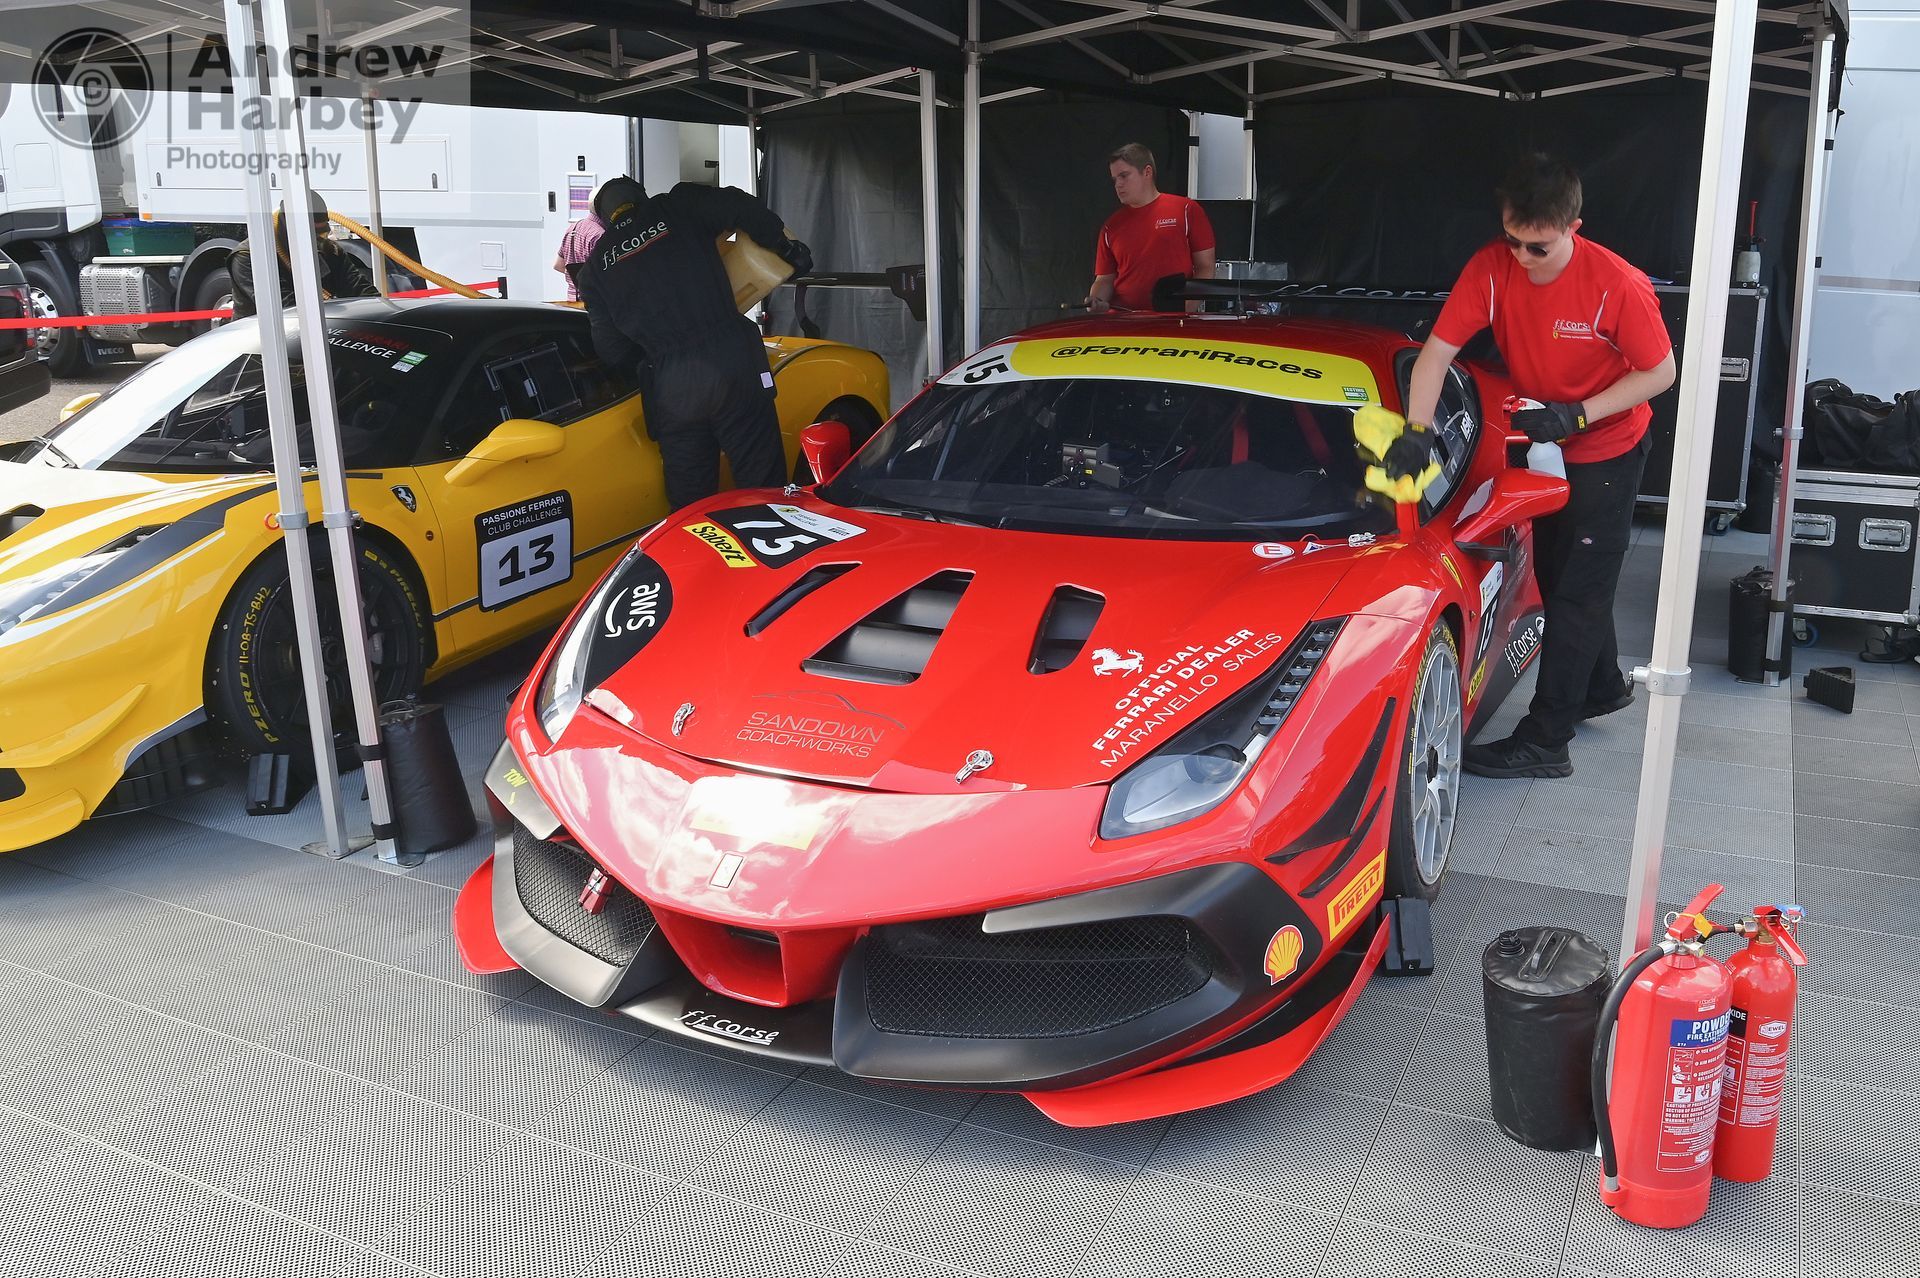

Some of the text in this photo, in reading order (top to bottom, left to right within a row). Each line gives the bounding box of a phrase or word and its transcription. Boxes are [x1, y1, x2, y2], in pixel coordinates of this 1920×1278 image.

[97, 347, 125, 356] IVECO
[327, 337, 397, 359] ALLENGE
[963, 345, 1324, 383] 15 @FerrariRaces
[482, 495, 565, 527] PASSIONE FERRARI
[487, 506, 563, 536] CLUB CHALLENGE
[691, 525, 747, 562] Sabelt
[498, 533, 555, 587] 13
[626, 582, 661, 631] aws
[1092, 628, 1255, 751] FERRARI DEALER
[1115, 644, 1204, 710] OFFICIAL
[1100, 632, 1282, 768] MARANELLO SALES
[748, 711, 885, 743] SANDOWN
[736, 729, 872, 758] COACHWORKS
[503, 768, 528, 787] TOW
[1333, 860, 1381, 929] PIRELLI
[1692, 1007, 1731, 1034] POWDE
[1686, 1033, 1703, 1041] FIRE
